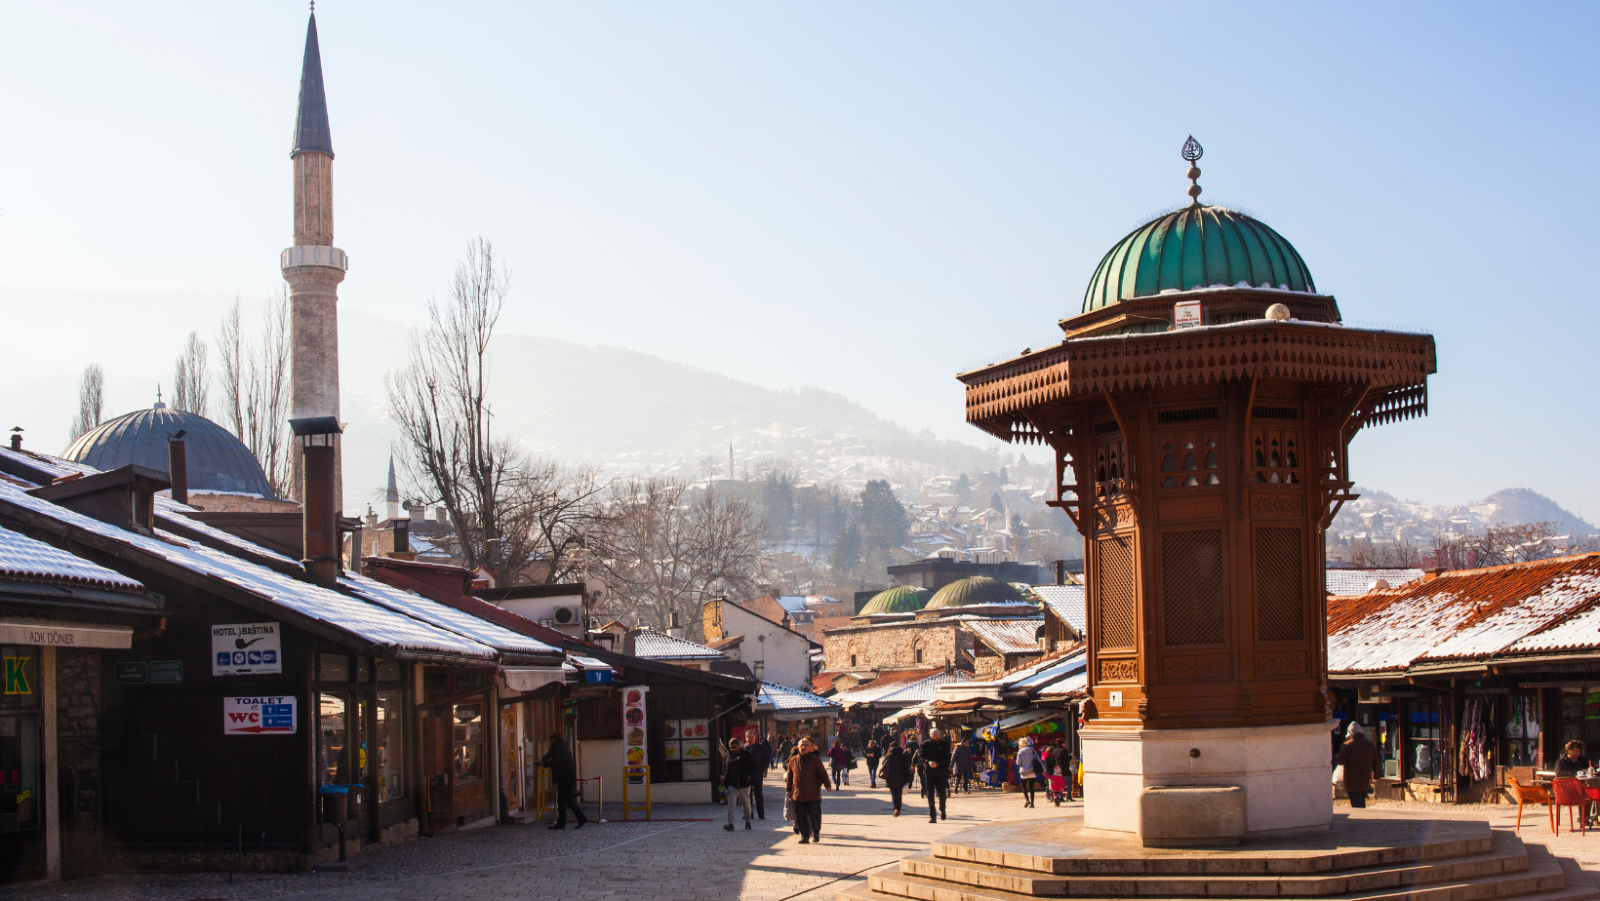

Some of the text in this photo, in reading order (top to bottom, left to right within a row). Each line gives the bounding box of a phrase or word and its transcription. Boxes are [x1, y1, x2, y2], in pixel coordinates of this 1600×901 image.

[213, 625, 274, 636] HOTEL BAŠTINA
[30, 631, 75, 645] ADK DÖNER
[228, 712, 259, 723] WC
